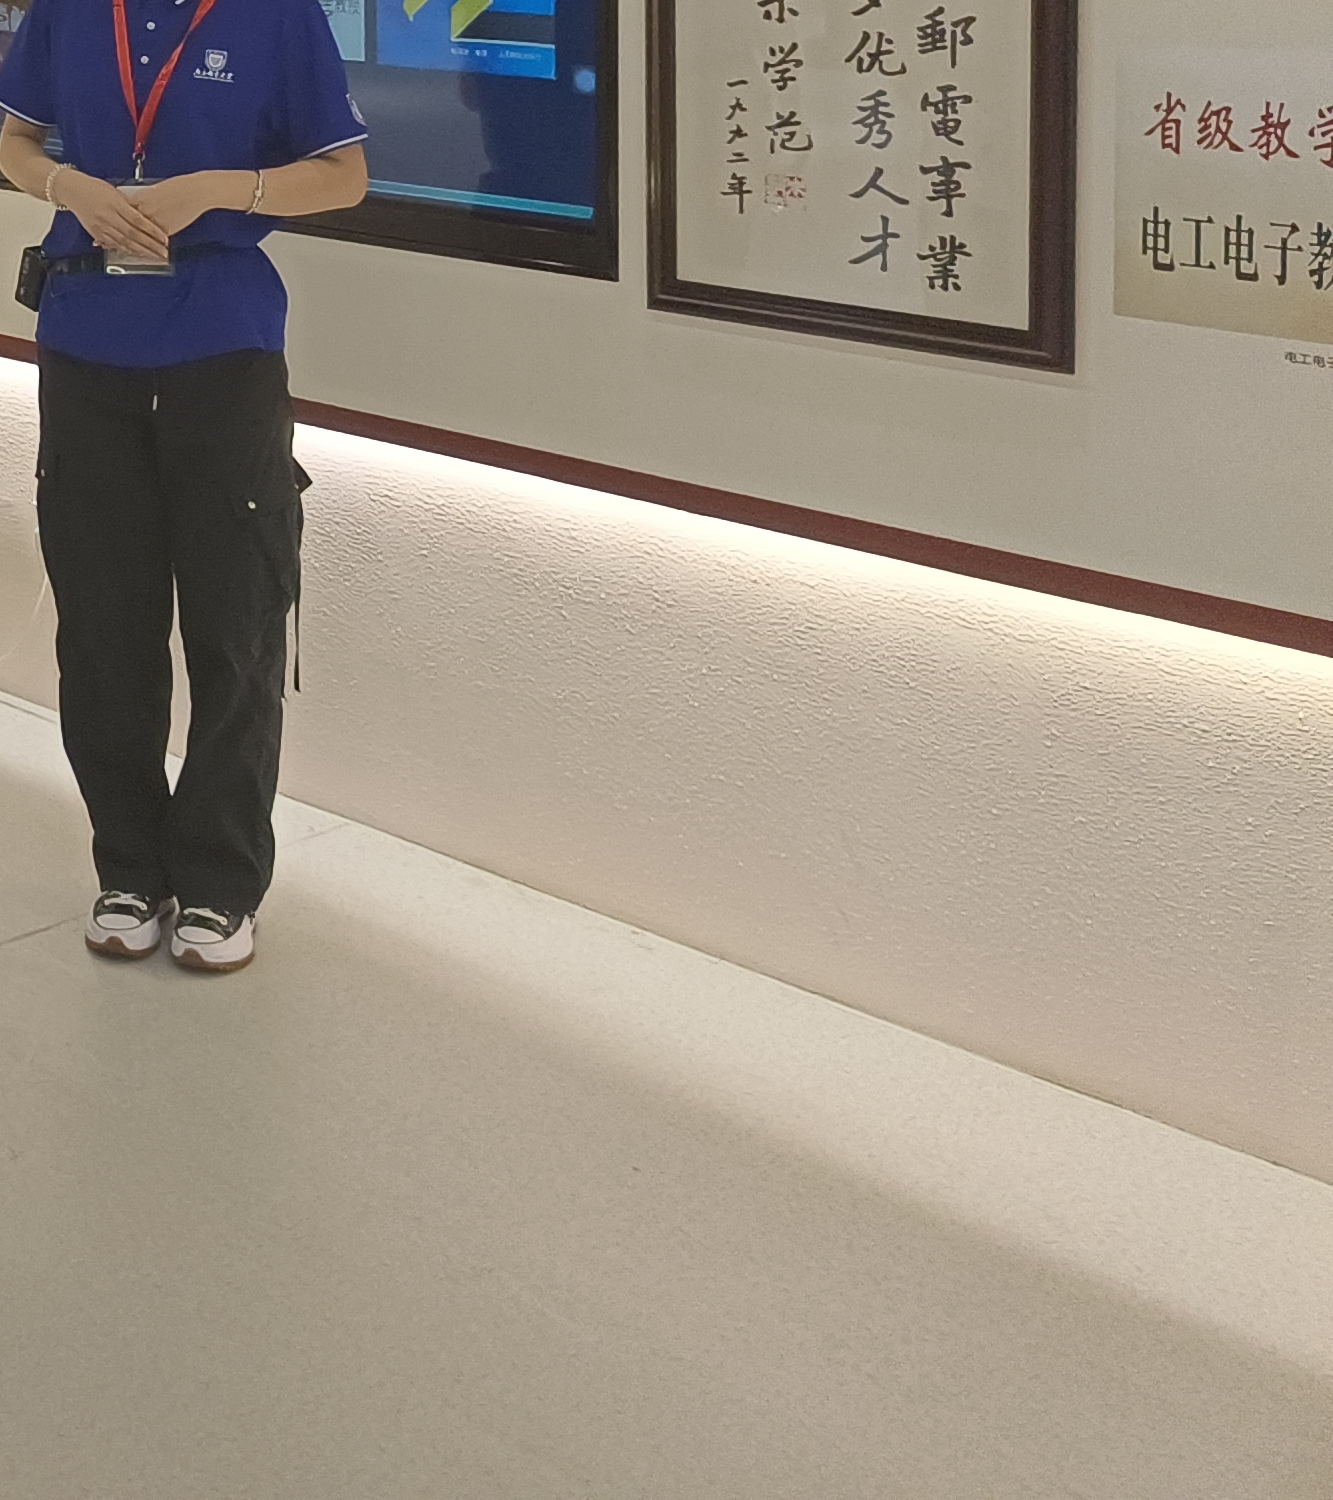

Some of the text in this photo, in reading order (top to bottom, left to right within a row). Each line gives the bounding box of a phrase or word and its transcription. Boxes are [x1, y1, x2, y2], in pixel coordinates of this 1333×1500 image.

[720, 79, 753, 214] 一九九二年
